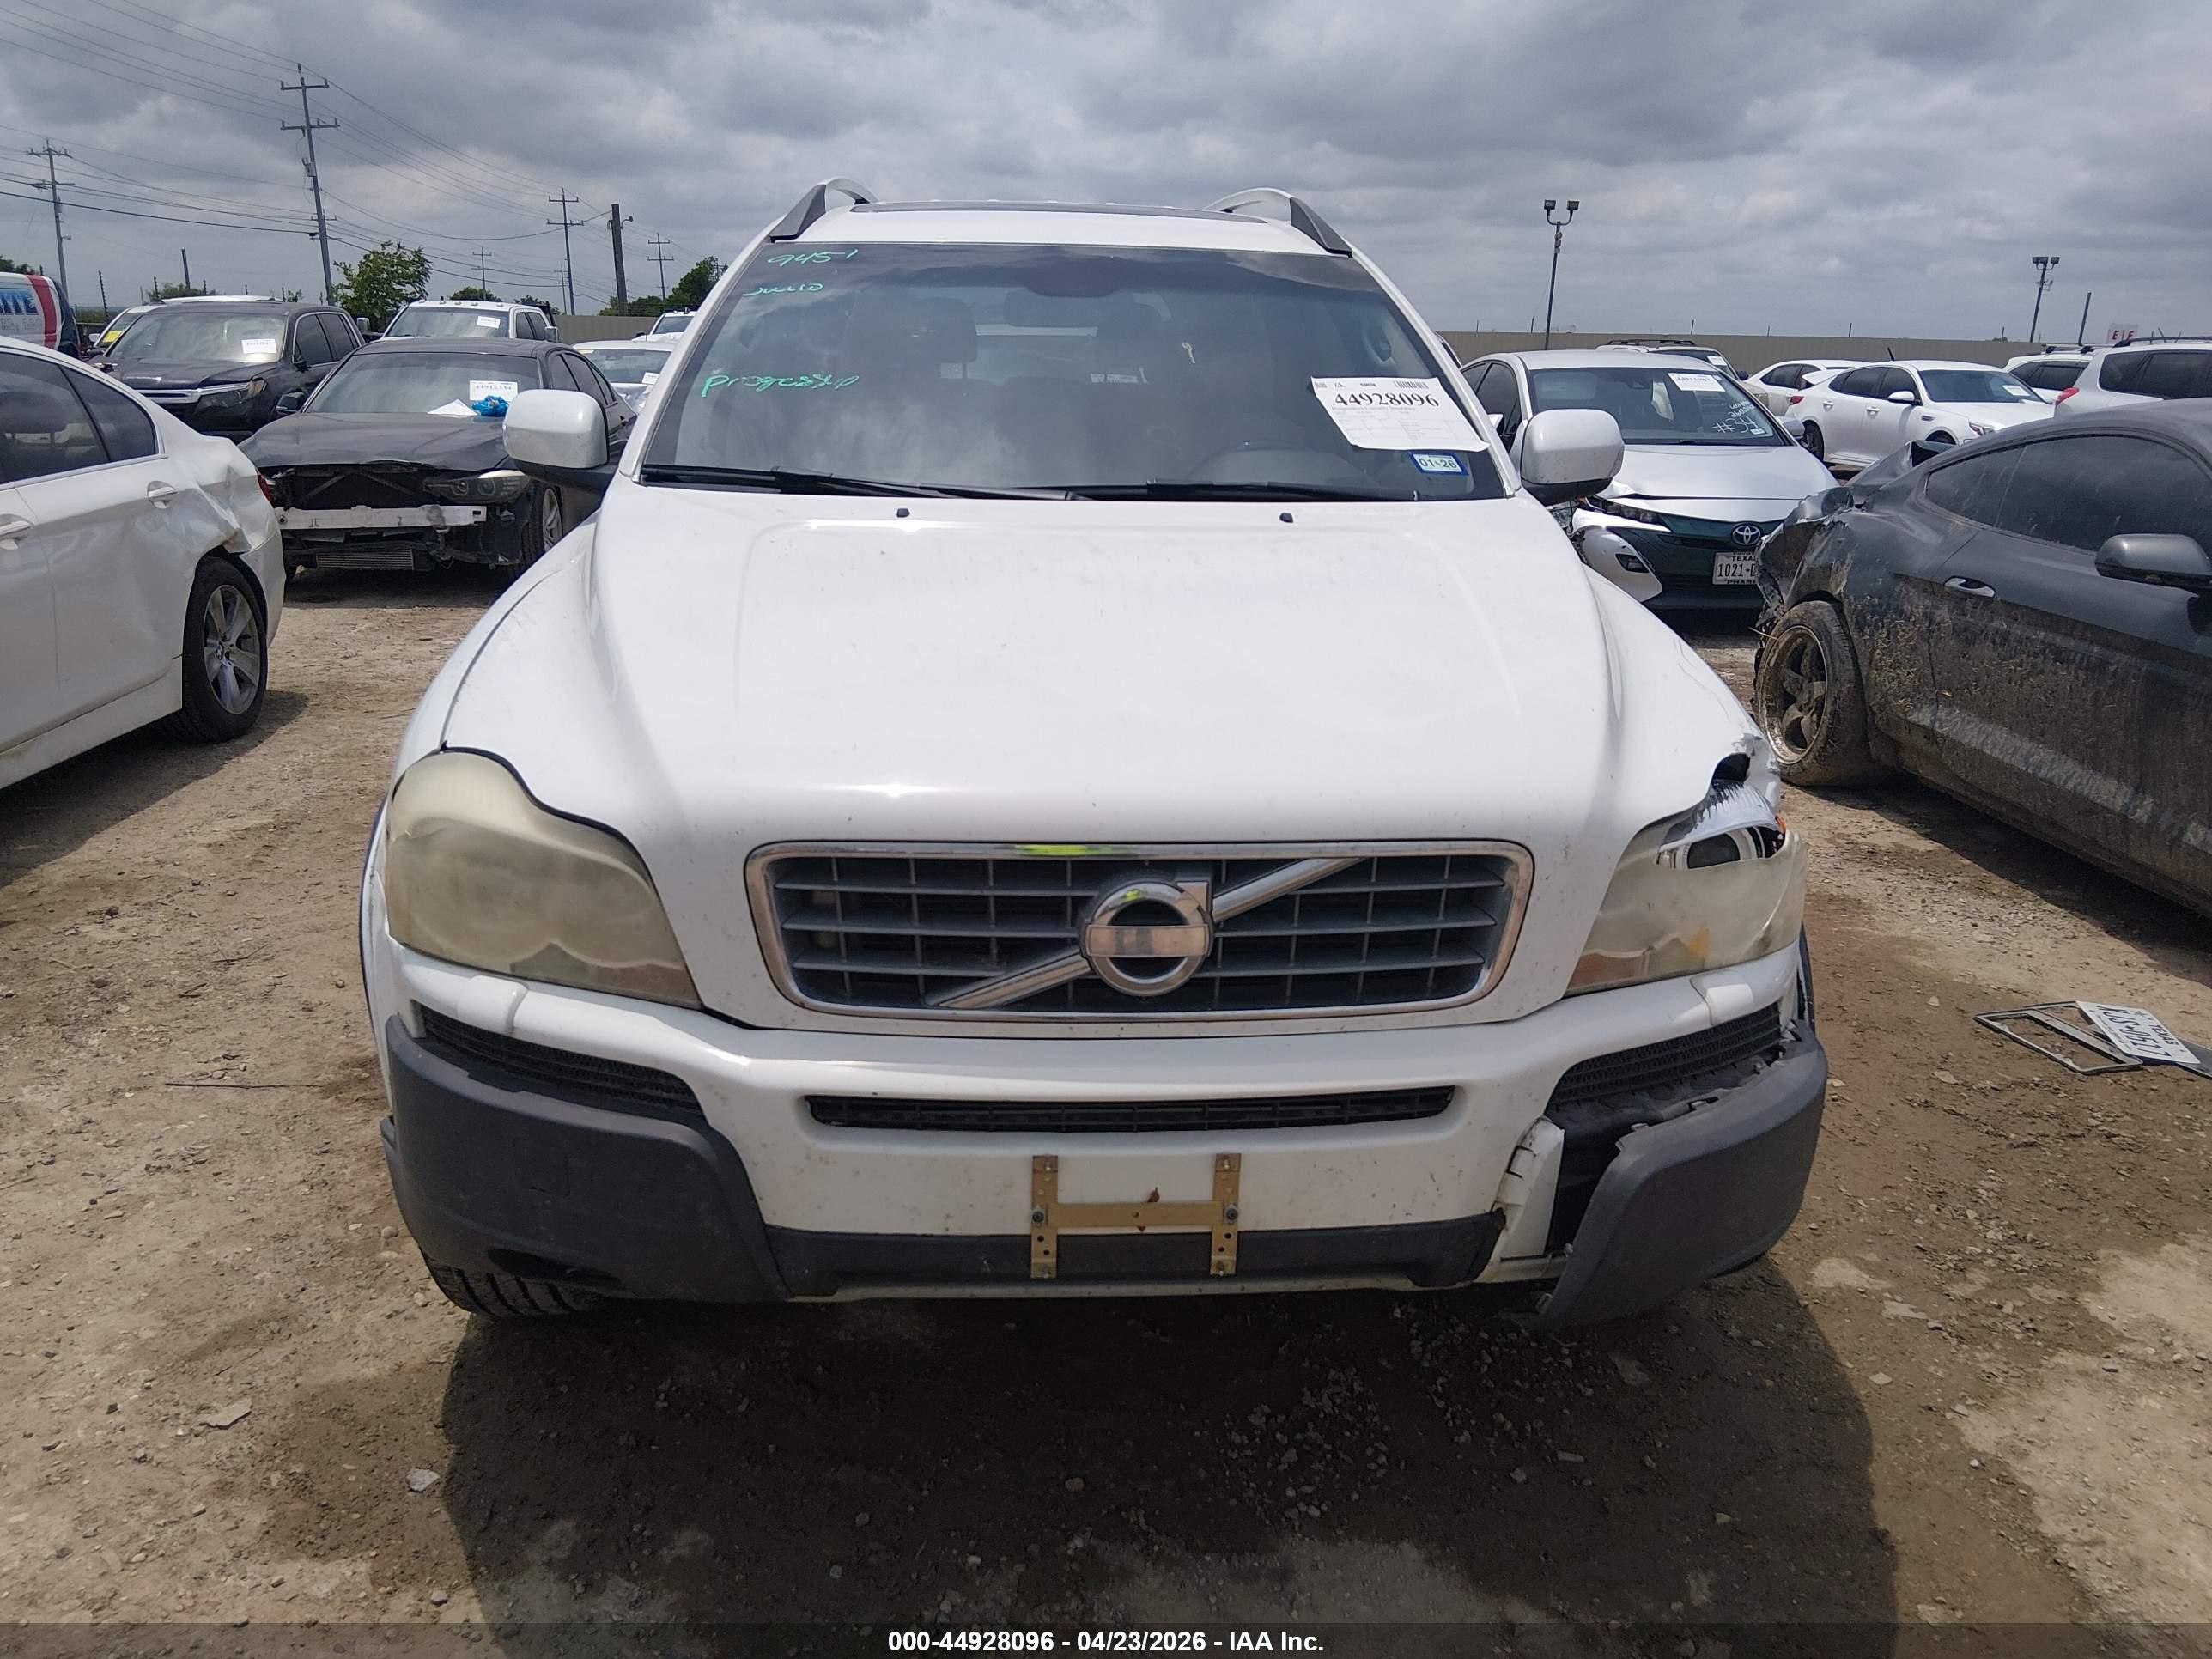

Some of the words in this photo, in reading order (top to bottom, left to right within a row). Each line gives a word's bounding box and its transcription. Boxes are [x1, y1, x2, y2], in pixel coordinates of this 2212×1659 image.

[767, 249, 858, 267] 9451
[1334, 392, 1440, 407] 44928096
[1440, 459, 1457, 469] 26
[2148, 1024, 2180, 1046] TEXAS
